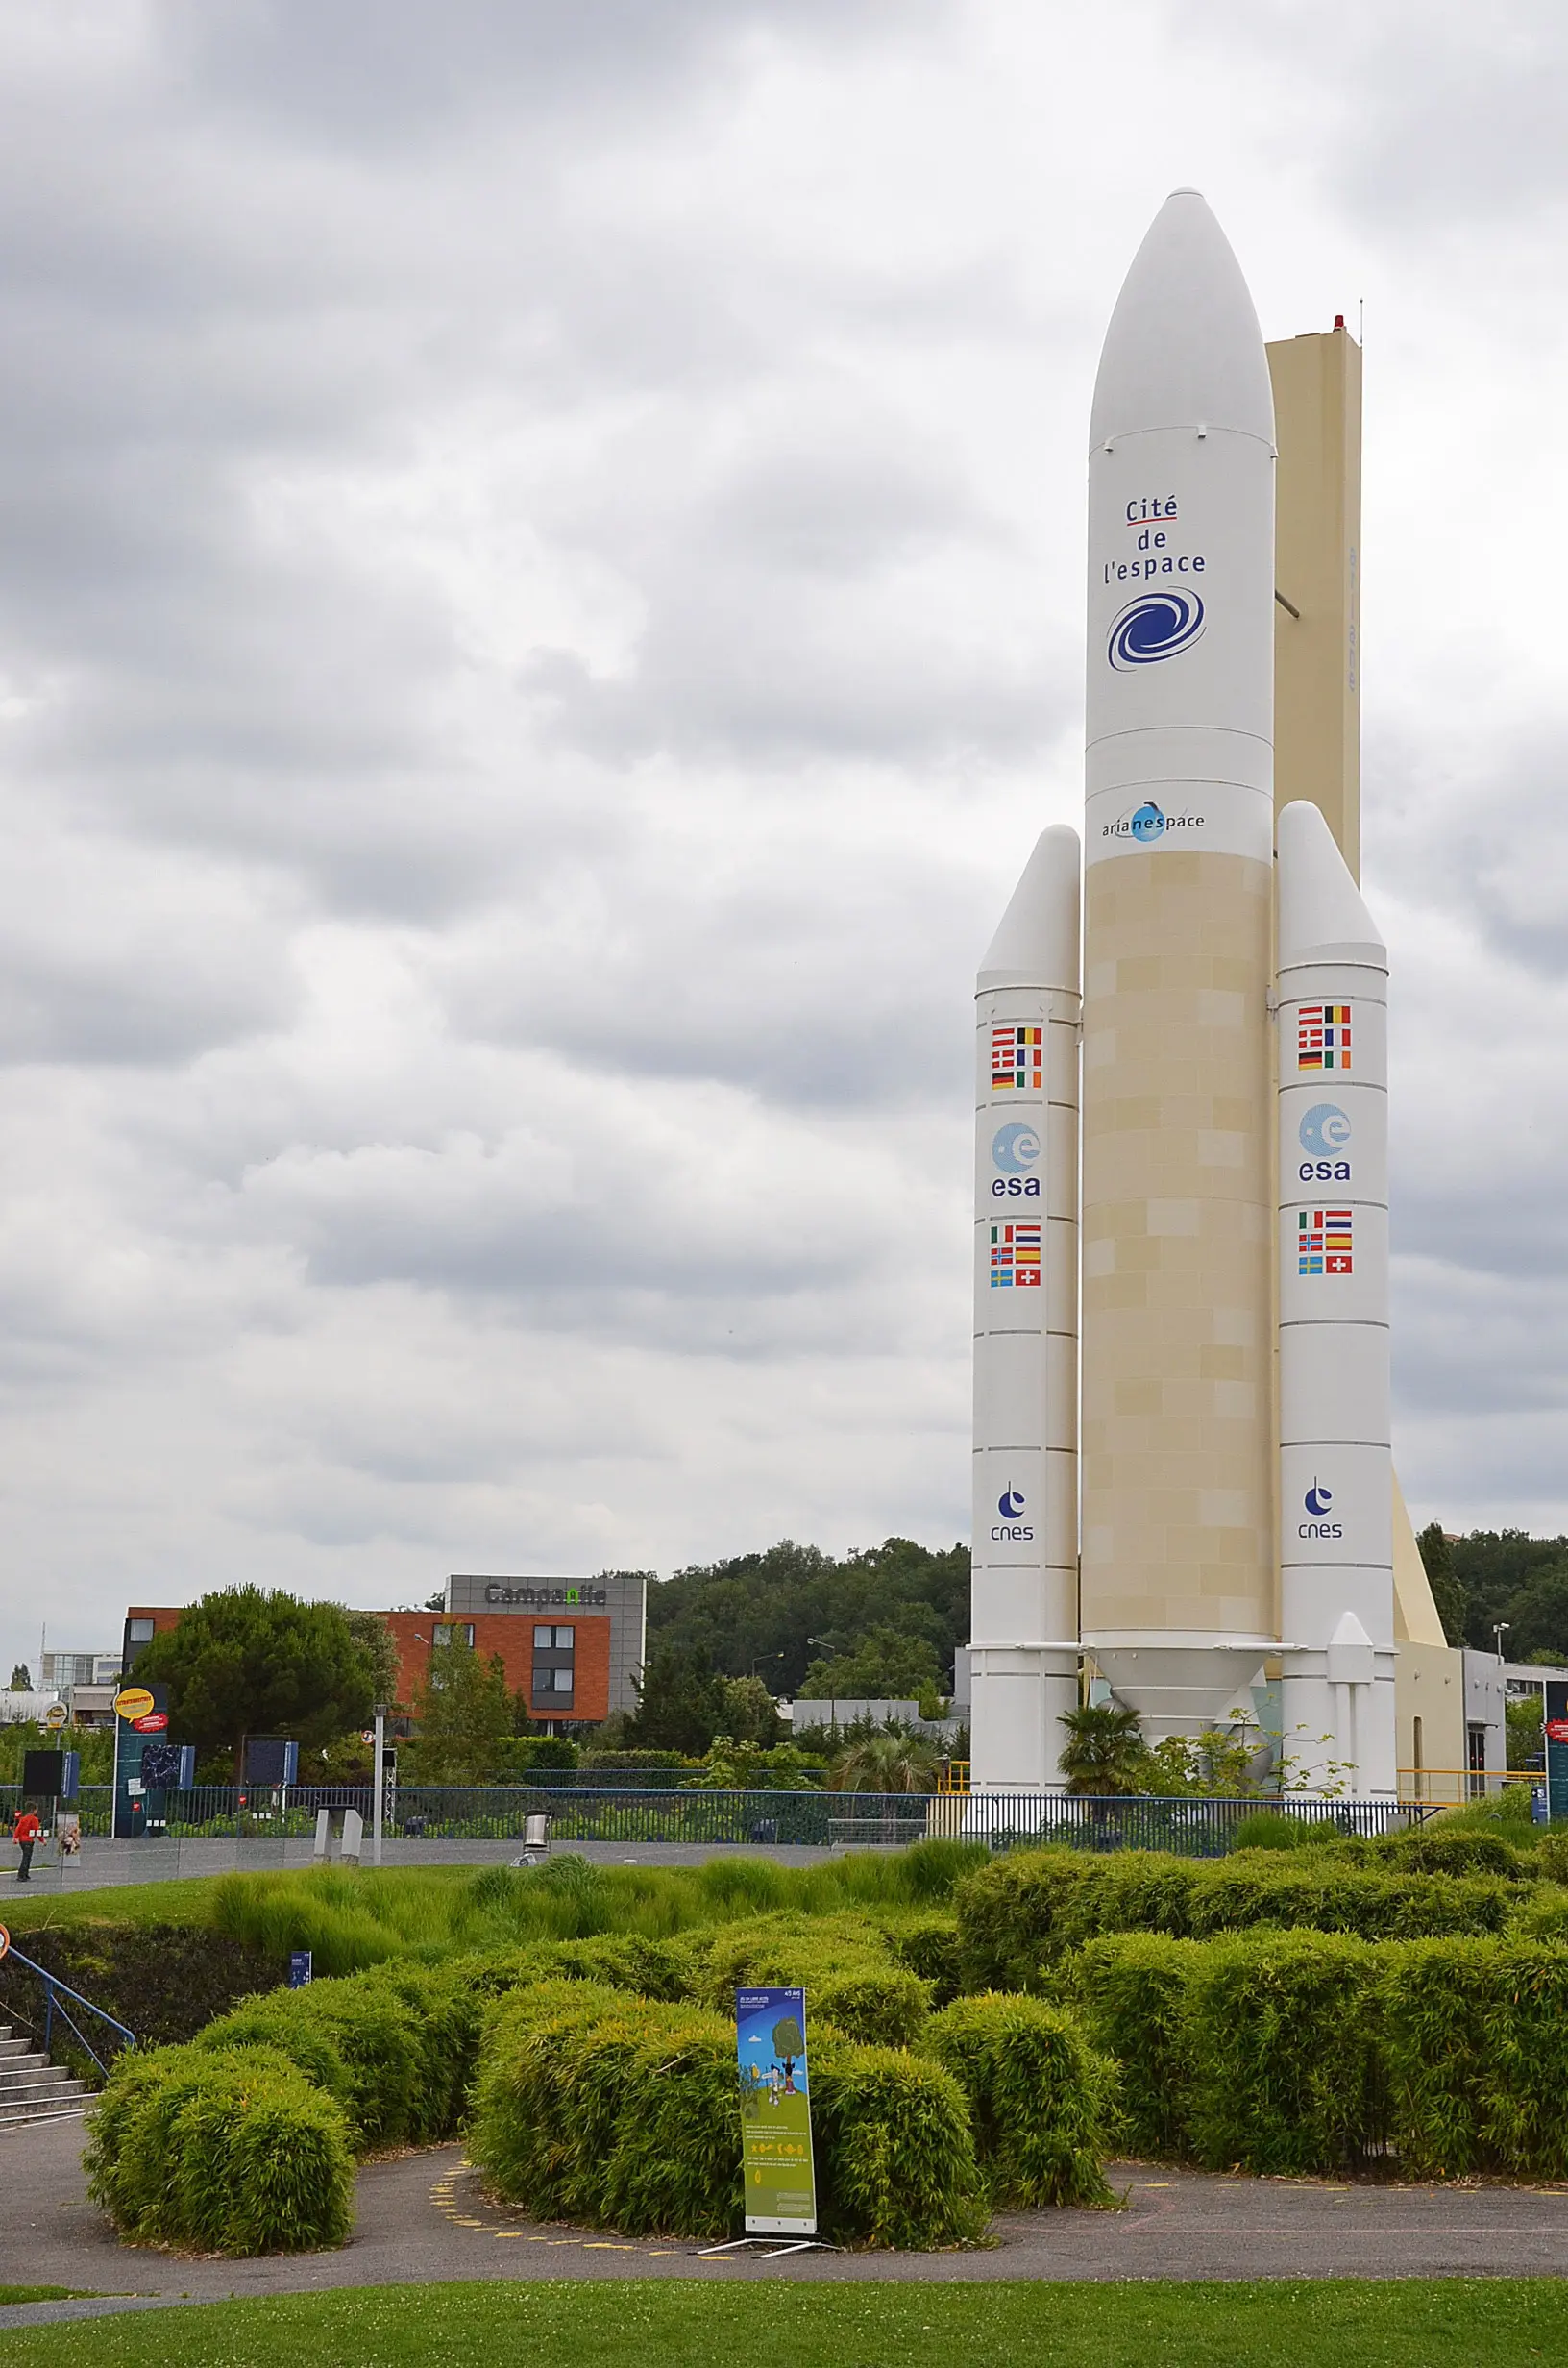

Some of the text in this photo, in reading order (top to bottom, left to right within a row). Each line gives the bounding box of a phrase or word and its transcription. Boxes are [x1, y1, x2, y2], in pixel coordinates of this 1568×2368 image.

[1126, 494, 1178, 522] Cité
[1137, 530, 1167, 551] de
[1104, 554, 1207, 584] l'espace
[1102, 814, 1206, 837] arianespace
[1298, 1160, 1352, 1182] esa
[992, 1177, 1041, 1197] esa
[991, 1526, 1034, 1541] cnes
[1298, 1523, 1342, 1539] cnes
[485, 1583, 606, 1611] Campanile
